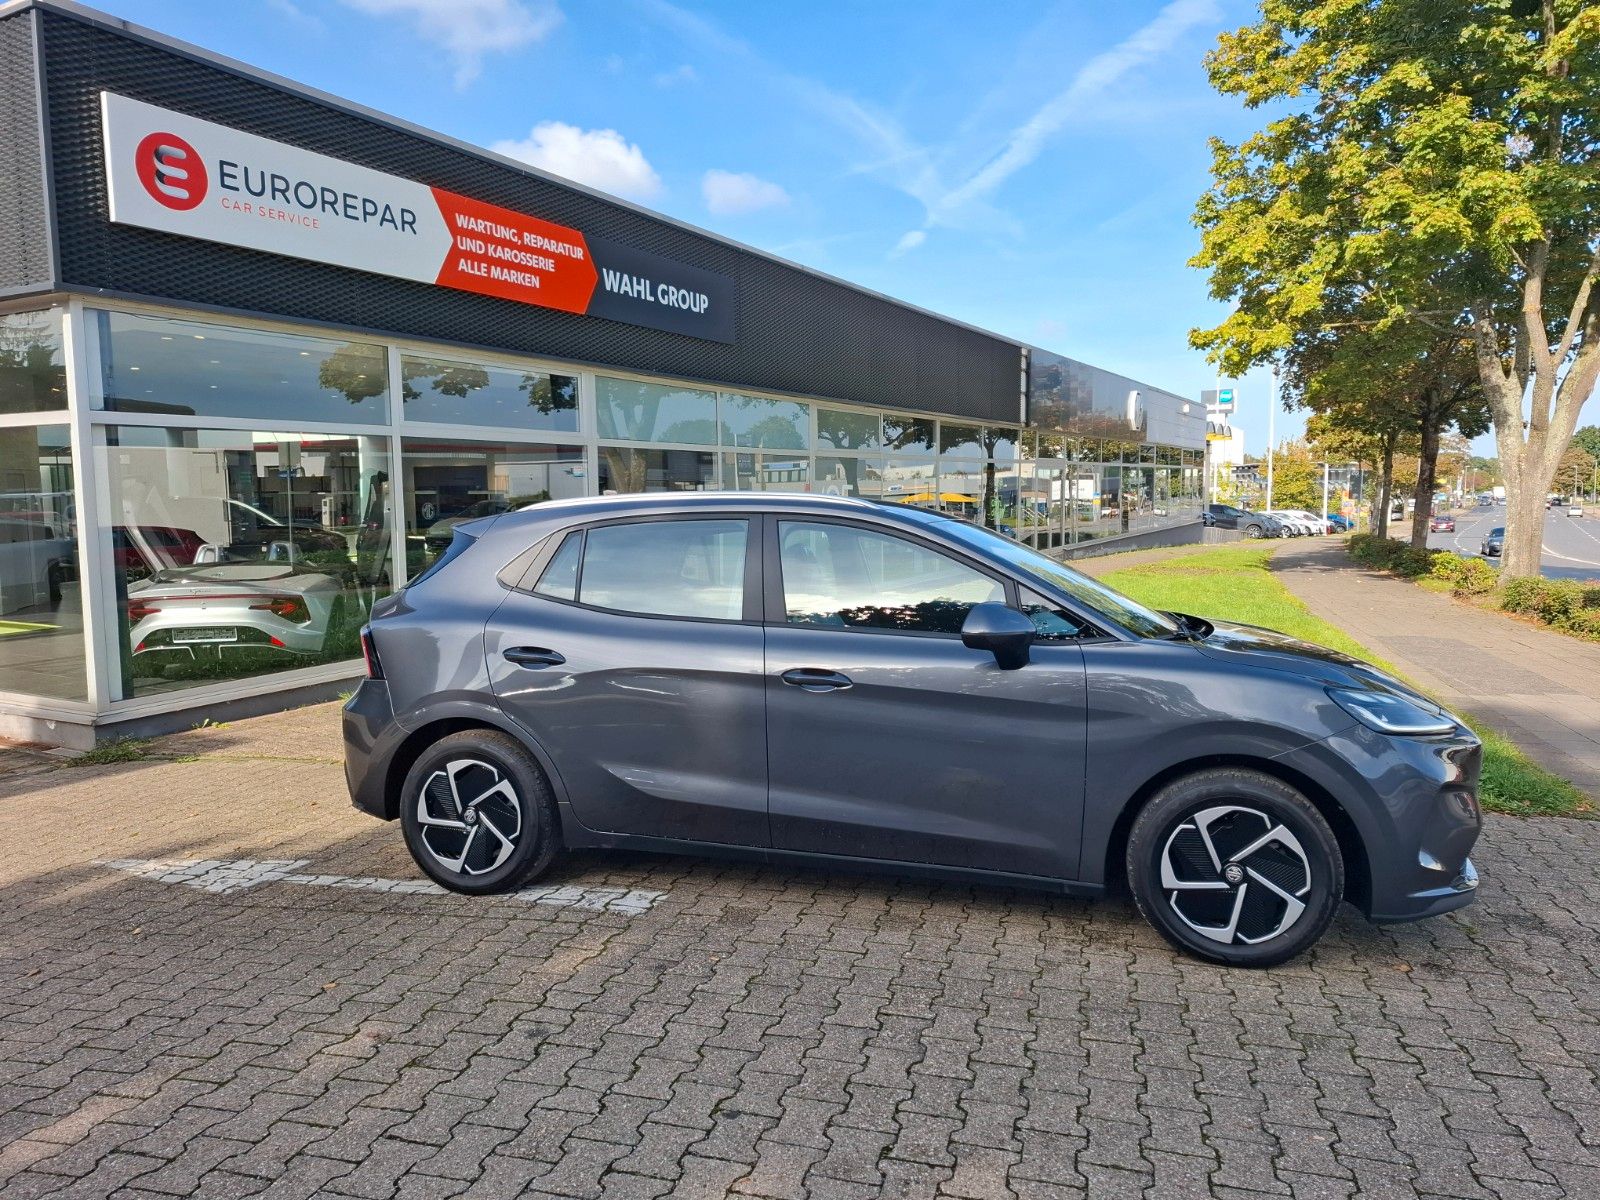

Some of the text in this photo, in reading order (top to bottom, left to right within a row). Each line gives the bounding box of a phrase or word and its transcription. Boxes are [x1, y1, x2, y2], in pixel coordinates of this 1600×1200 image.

[218, 160, 417, 235] EUROREPAR
[221, 198, 320, 229] CAR SERVICE
[455, 213, 584, 260] WARTUNG, REPARATUR
[457, 235, 556, 272] UND KAROSSERIE
[458, 258, 540, 289] ALLE MARKEN
[602, 268, 709, 314] WAHL GROUP
